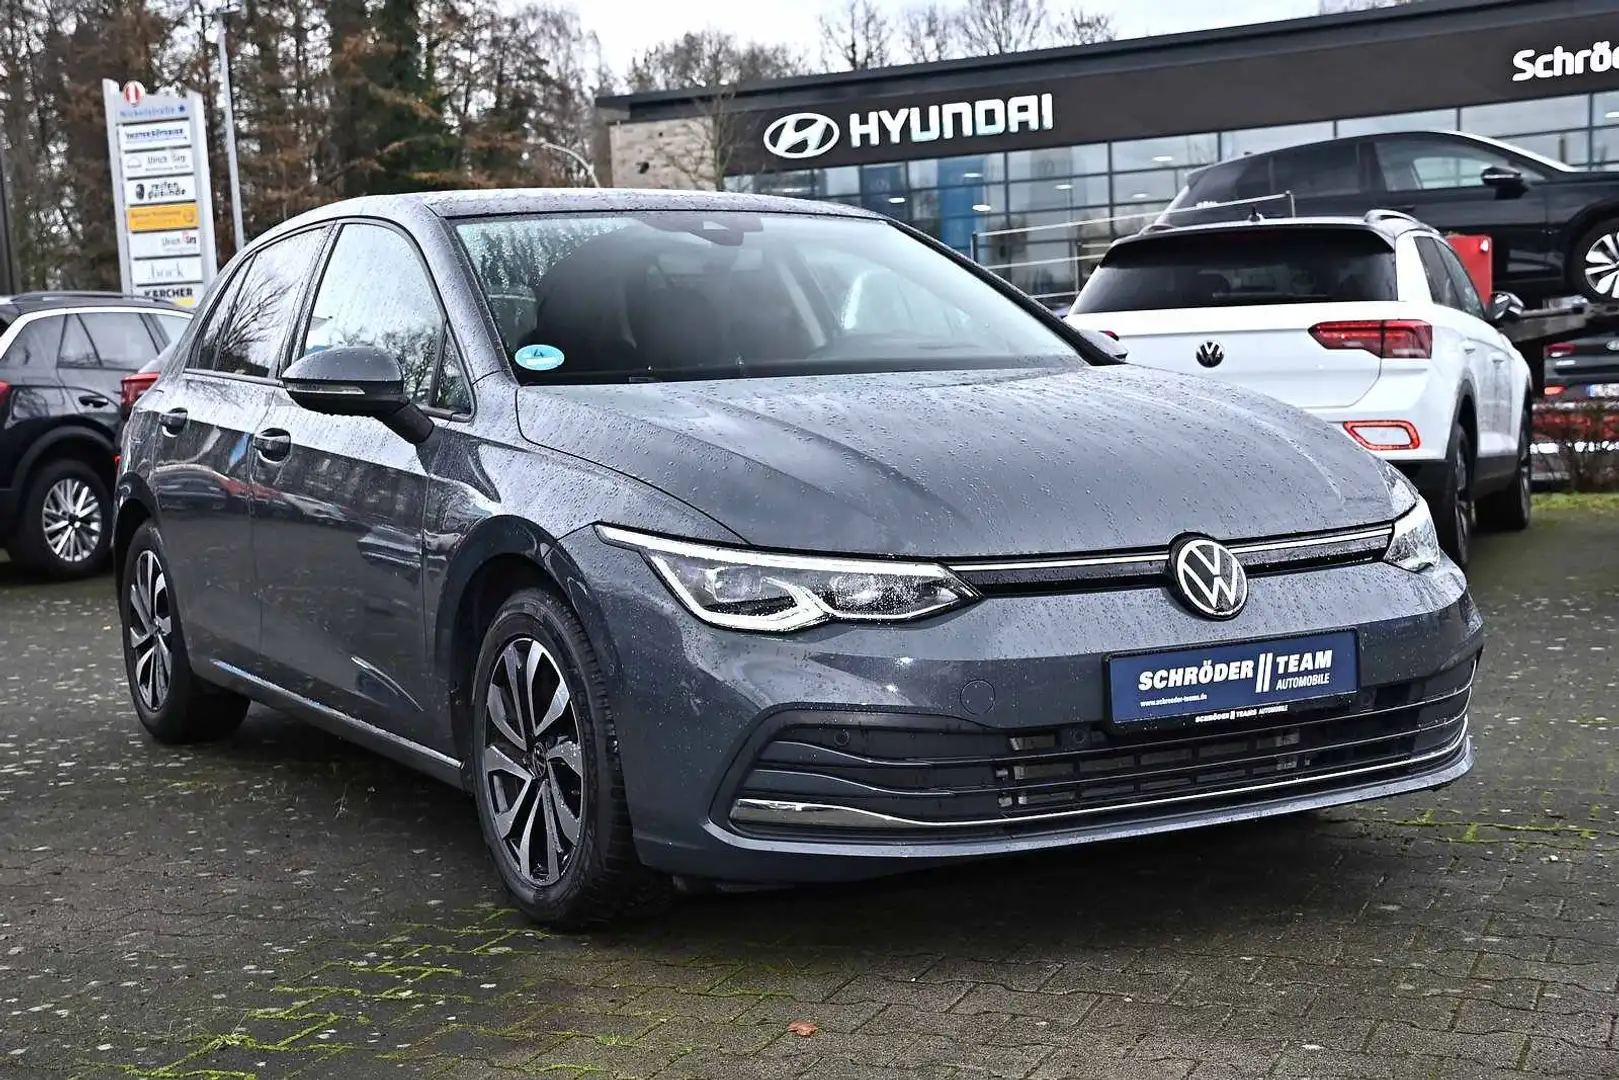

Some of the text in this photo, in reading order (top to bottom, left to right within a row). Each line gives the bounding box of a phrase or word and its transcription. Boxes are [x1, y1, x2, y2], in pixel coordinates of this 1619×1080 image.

[850, 93, 1053, 148] HYUNDAI
[1138, 650, 1333, 692] SCHRÖDER TEAM
[1276, 673, 1331, 691] AUTOMOBILE
[1195, 712, 1230, 722] SCHRÖDER
